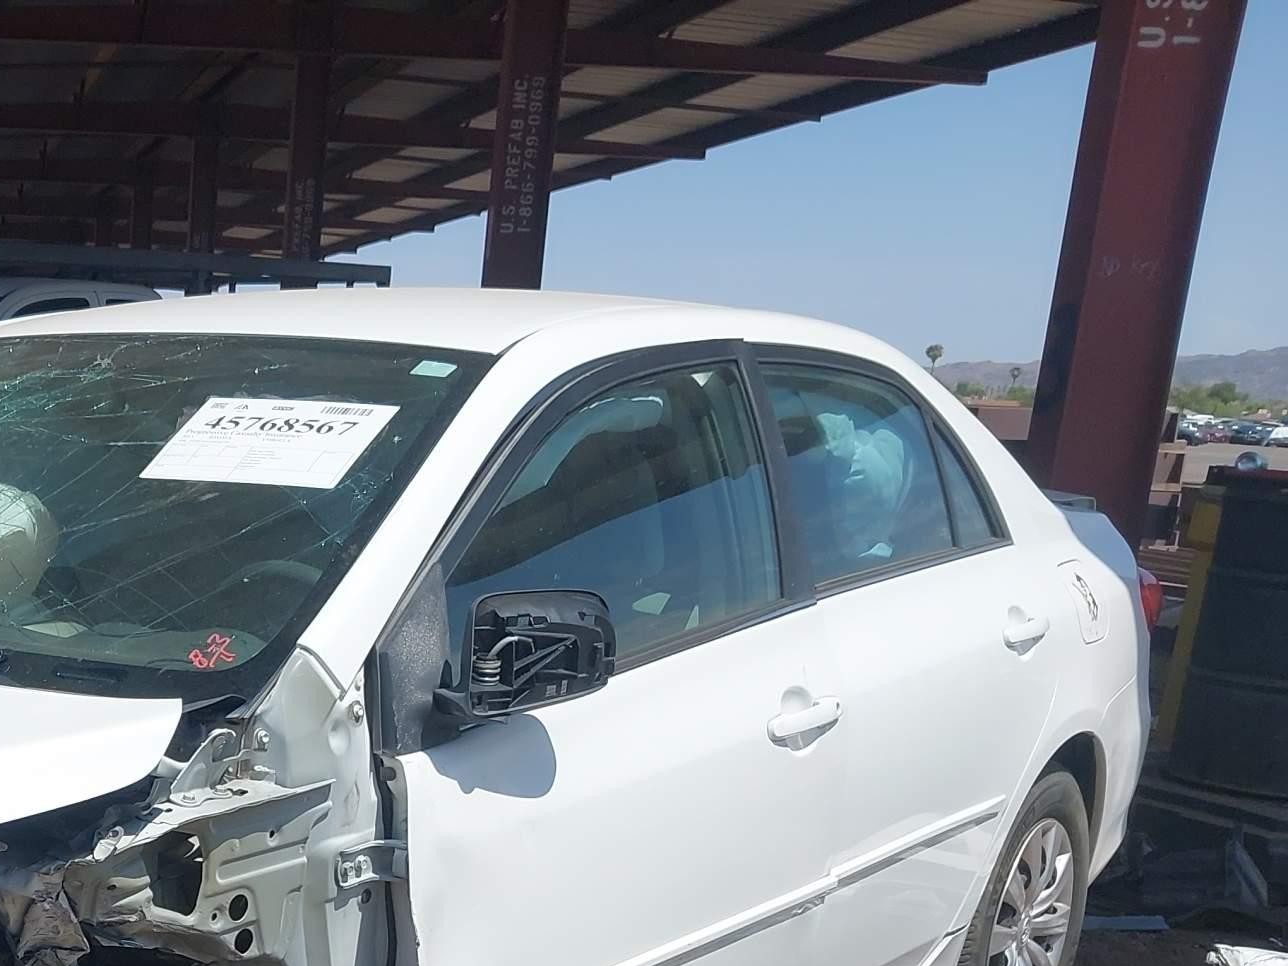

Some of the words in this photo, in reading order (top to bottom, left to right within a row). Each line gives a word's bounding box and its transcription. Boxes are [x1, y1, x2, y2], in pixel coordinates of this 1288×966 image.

[513, 75, 530, 109] INC.
[505, 119, 524, 190] PREFAB
[517, 76, 546, 233] 1-866-799-0969
[499, 200, 516, 234] U.S.
[203, 415, 360, 438] 45768567
